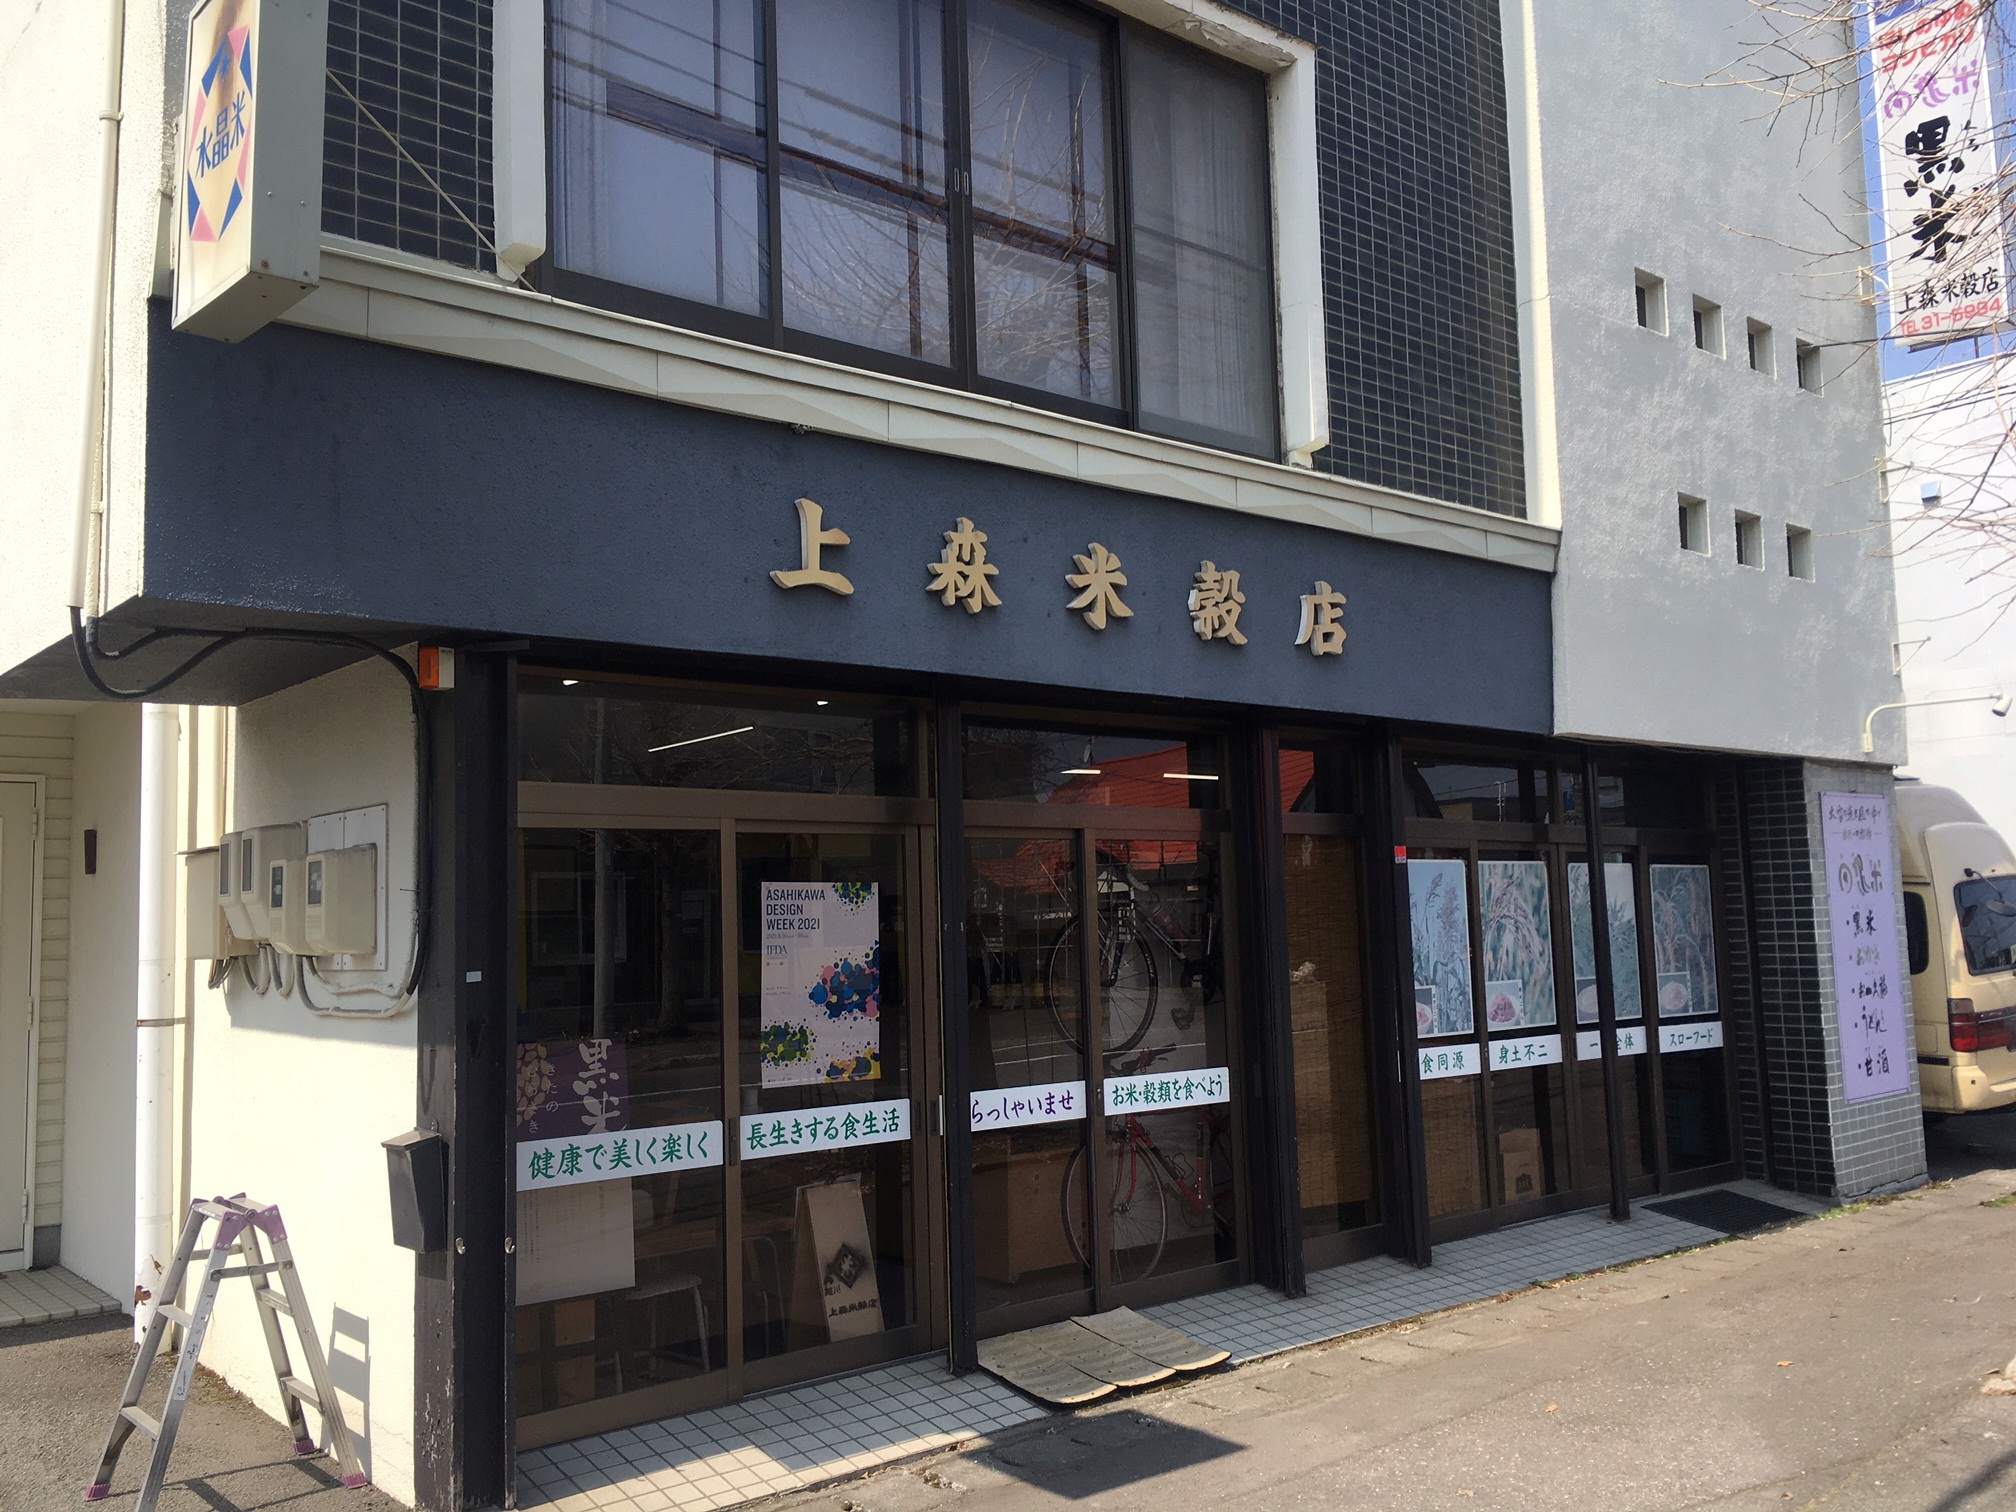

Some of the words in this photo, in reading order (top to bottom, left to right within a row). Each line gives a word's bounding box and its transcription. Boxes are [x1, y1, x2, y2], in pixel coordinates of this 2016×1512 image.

[195, 89, 247, 178] 水晶米
[1904, 115, 1980, 264] 黒米
[1898, 267, 1998, 315] 上森米穀店
[1900, 320, 1919, 336] TEL
[769, 498, 1348, 656] 上森米穀店
[766, 889, 826, 900] ASAHIKAWA
[766, 903, 803, 916] DESIGN
[766, 918, 795, 930] WEEK
[797, 918, 820, 930] 2021
[1853, 909, 1877, 937] 黒米
[1669, 1028, 1714, 1047] スローフード
[1420, 1050, 1465, 1073] 食同源
[1498, 1044, 1548, 1065] 身土不二
[573, 1038, 628, 1134] 黒米
[971, 1089, 1074, 1124] らっしゃいませ
[746, 1107, 900, 1151] 長生きする食生活
[528, 1131, 709, 1181] 健康で美しく楽しく
